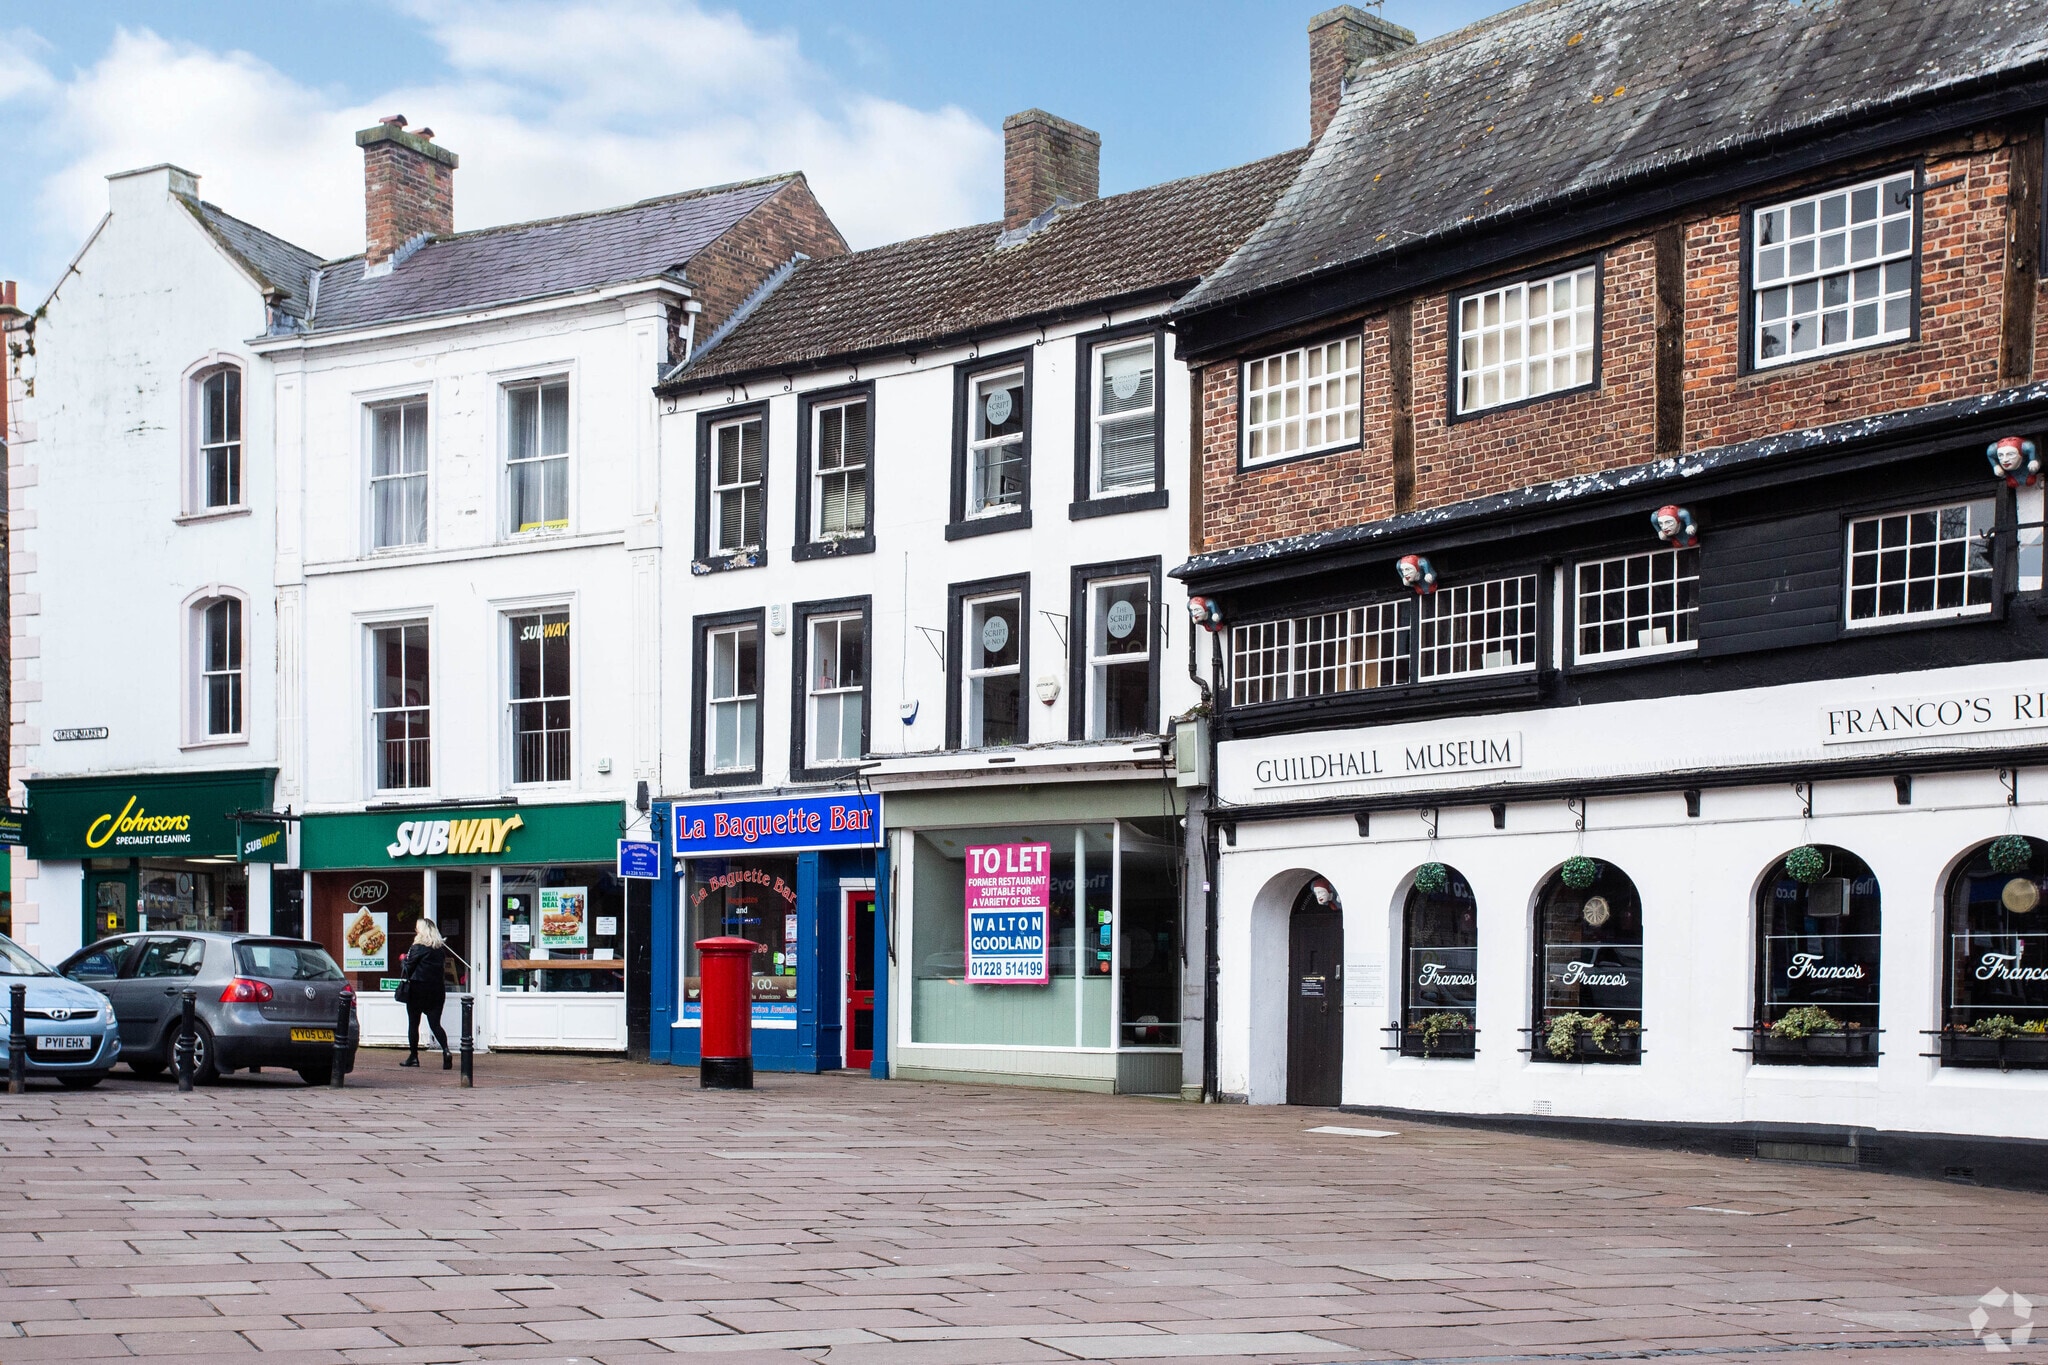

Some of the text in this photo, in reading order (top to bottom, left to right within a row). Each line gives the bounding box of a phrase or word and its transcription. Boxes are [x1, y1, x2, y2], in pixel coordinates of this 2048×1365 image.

[1110, 613, 1133, 623] SCRIPT
[985, 628, 1005, 637] SCRIPT
[1827, 692, 2048, 735] FRANCO'S RI
[79, 728, 103, 739] MARKET
[1256, 738, 1512, 783] GUILDHALL MUSEUM
[86, 795, 190, 848] Johnsons
[679, 805, 873, 843] La Baguette Bar
[116, 834, 191, 845] SPECIALIST CLEANING
[244, 831, 280, 854] SUBWAY
[387, 813, 524, 859] SUBWAY
[970, 846, 1047, 874] TO LET
[690, 868, 797, 907] La Baguette Bar
[968, 876, 1046, 887] FORMER RESTAURANT
[353, 886, 382, 899] OPEN
[981, 886, 1032, 897] SUITABLE FOR
[972, 896, 1041, 907] A VARIETY OF USES
[736, 906, 748, 914] and
[973, 917, 1041, 932] WALTON
[972, 936, 1042, 950] GOODLAND
[971, 961, 1043, 976] 01228 514199
[1976, 953, 2048, 980] Franco
[294, 1029, 332, 1040] YY05 LXG
[66, 1037, 84, 1048] EHX
